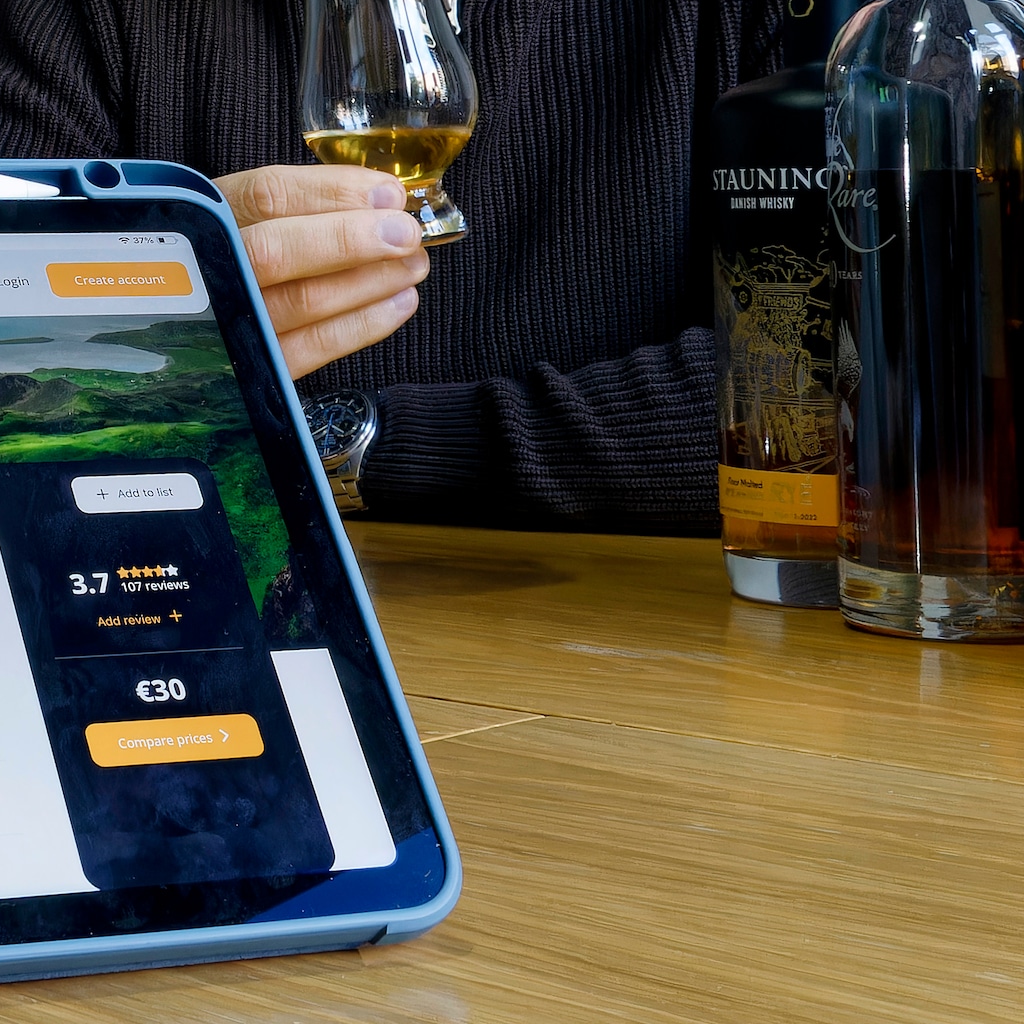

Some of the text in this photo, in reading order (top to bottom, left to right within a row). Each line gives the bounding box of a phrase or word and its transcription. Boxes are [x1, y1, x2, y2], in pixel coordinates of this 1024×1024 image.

[730, 197, 795, 209] DANISH WHISKY
[133, 236, 154, 244] 37%
[74, 273, 166, 286] Create account
[118, 487, 174, 498] Add to list
[69, 572, 109, 595] 3.7
[120, 579, 190, 593] 107 reviews
[97, 613, 161, 627] Add review
[135, 678, 187, 703] €30
[118, 731, 213, 750] Compare prices
